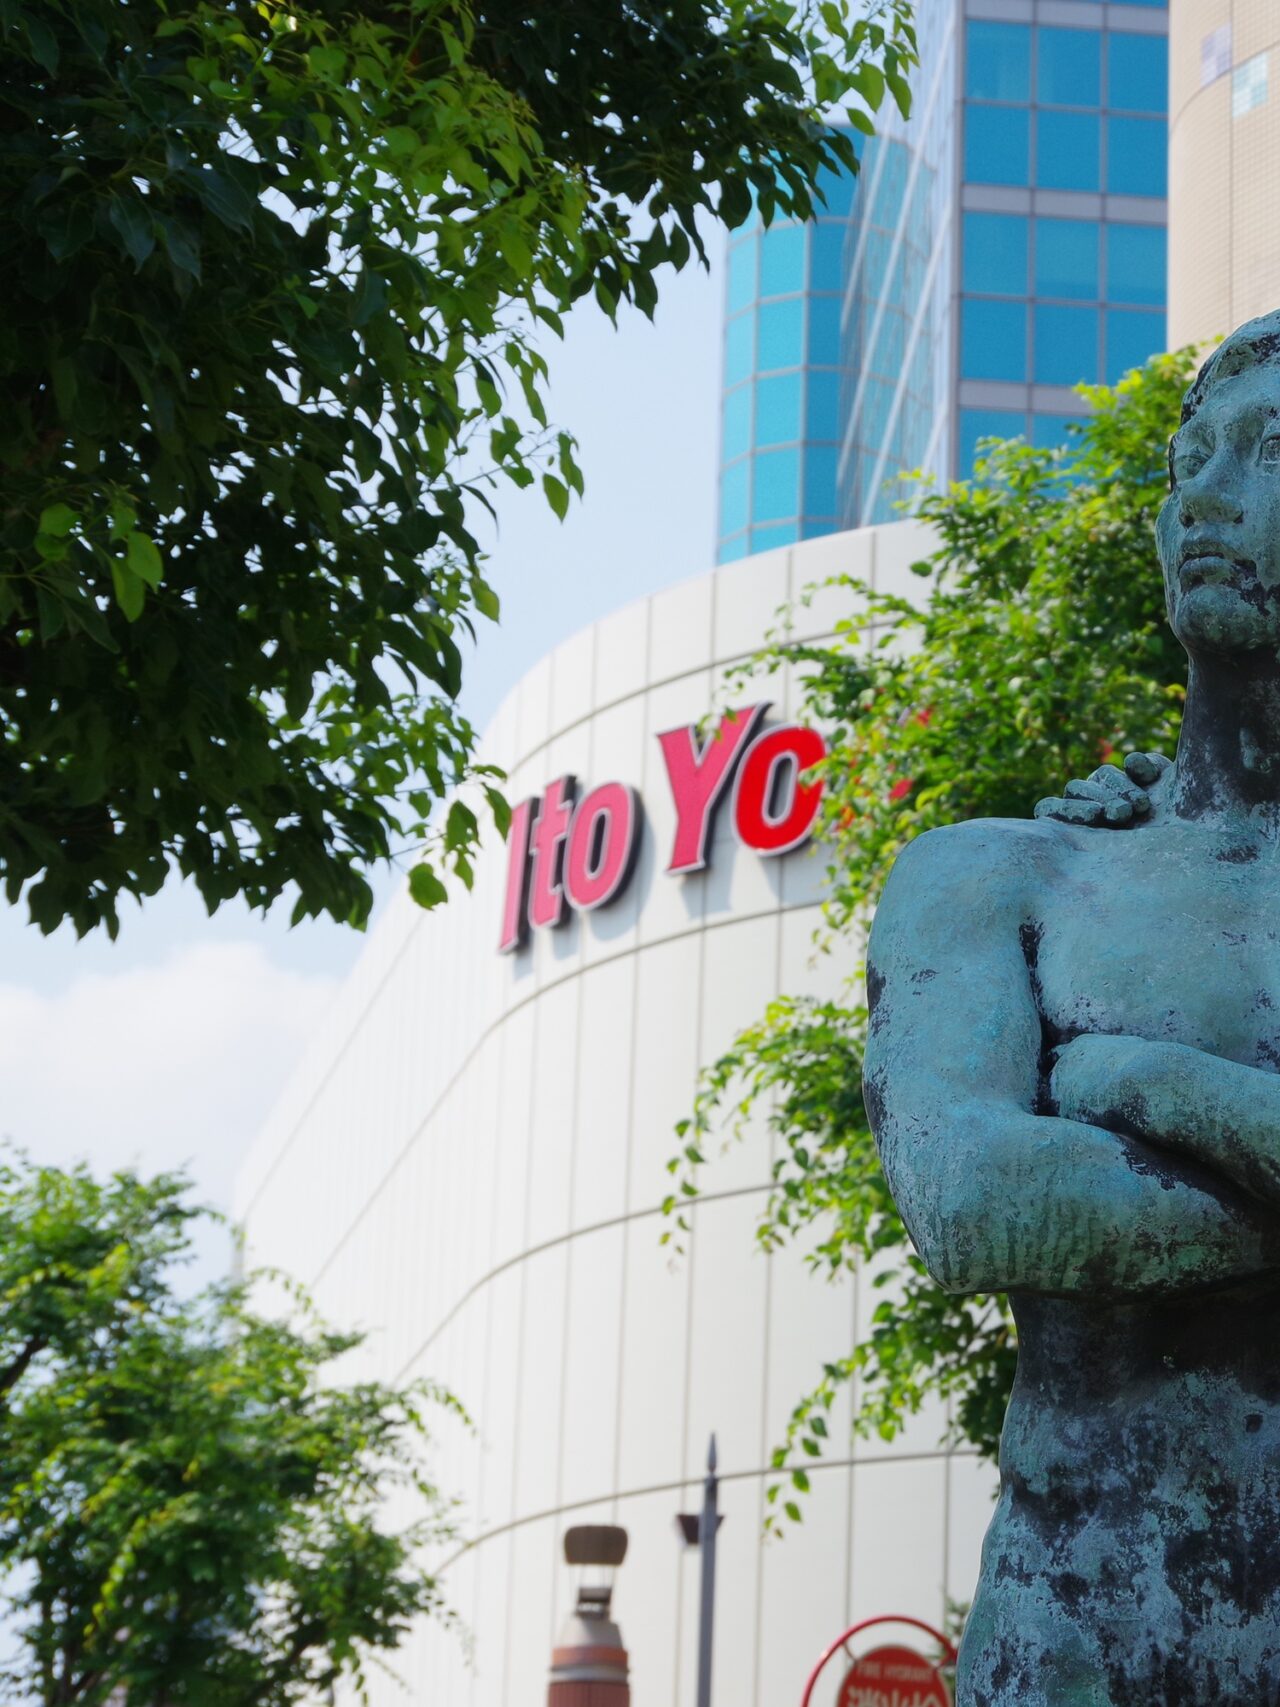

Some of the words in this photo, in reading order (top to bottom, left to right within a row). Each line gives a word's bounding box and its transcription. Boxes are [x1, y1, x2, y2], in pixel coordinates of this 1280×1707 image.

[497, 775, 641, 955] Ito
[857, 1661, 881, 1679] FIRE
[886, 1665, 934, 1684] HYDRANT
